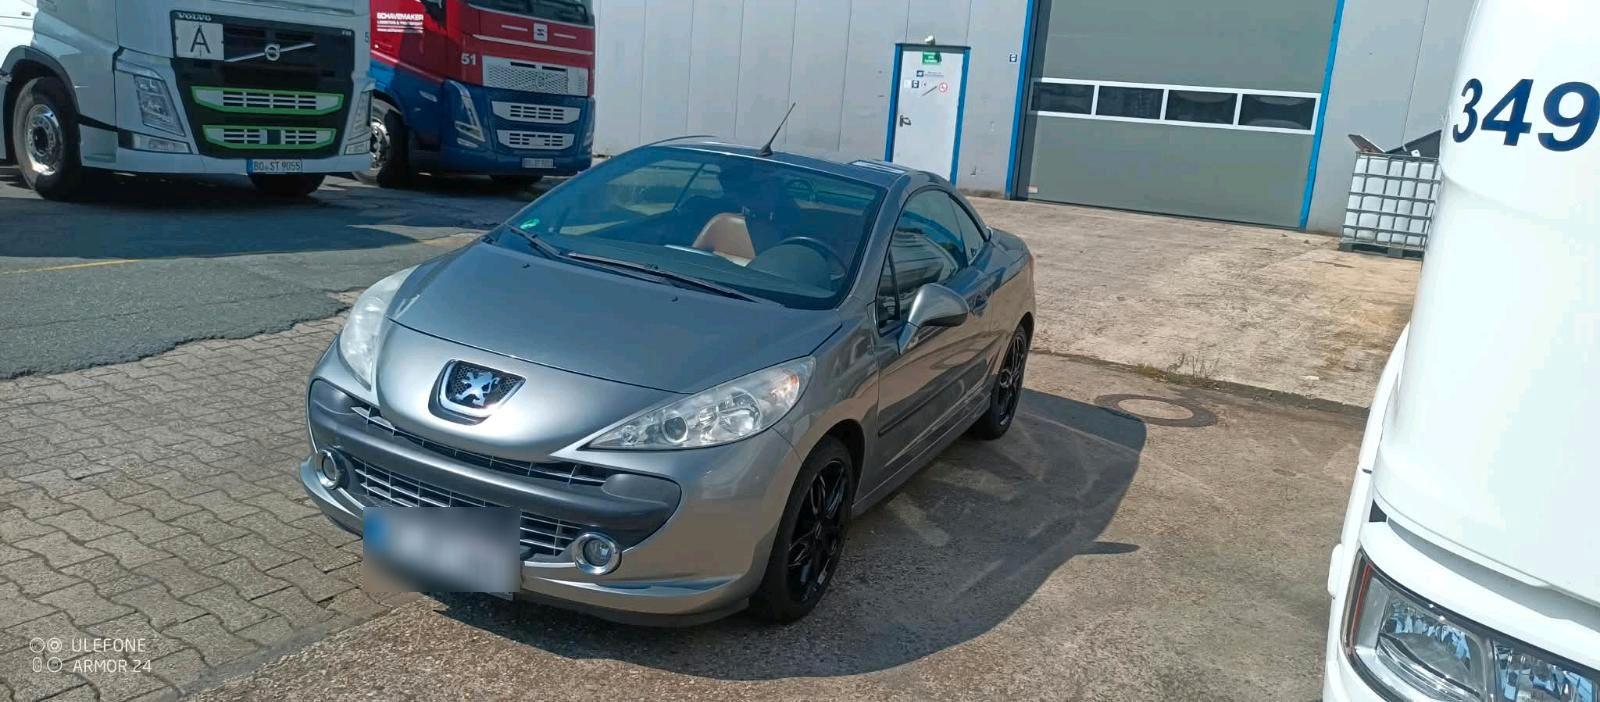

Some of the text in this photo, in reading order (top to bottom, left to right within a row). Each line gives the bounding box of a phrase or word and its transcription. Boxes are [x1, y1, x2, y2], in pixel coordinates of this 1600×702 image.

[177, 12, 212, 22] VOLVO
[190, 25, 211, 54] A
[461, 53, 476, 65] 51
[1453, 78, 1600, 152] 349
